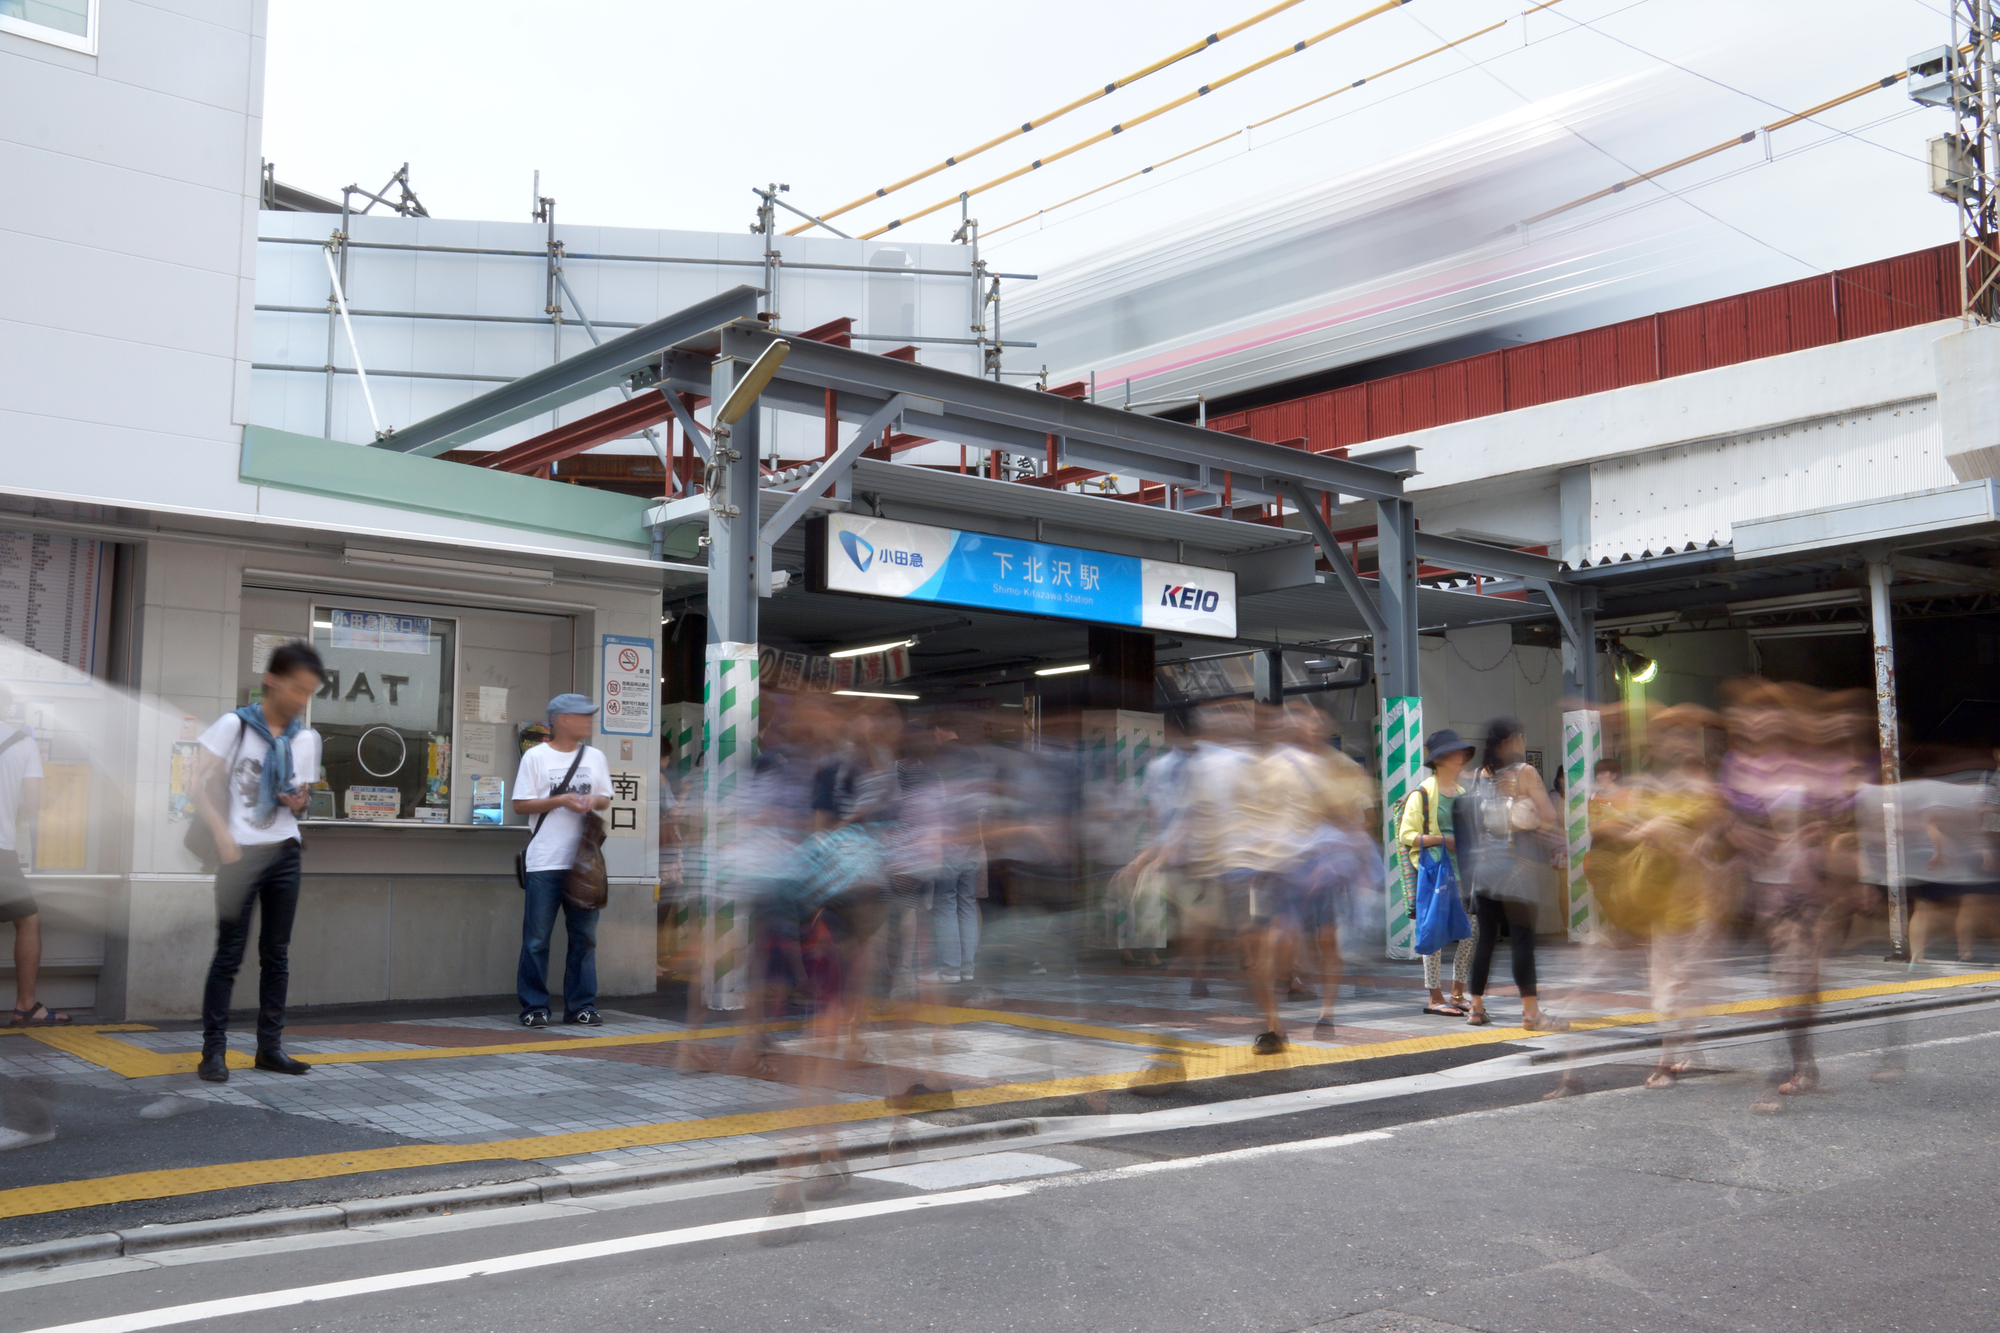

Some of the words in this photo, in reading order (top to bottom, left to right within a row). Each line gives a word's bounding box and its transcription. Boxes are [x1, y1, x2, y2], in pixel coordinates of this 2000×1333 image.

[879, 548, 924, 568] 小田急
[992, 551, 1101, 591] 下北沢駅
[992, 583, 1062, 601] Shimo-Kitazawa
[1064, 592, 1094, 606] Station
[1160, 584, 1220, 613] KEIO
[334, 612, 379, 631] 小田急
[384, 617, 413, 632] 窓口
[610, 772, 641, 830] 南口
